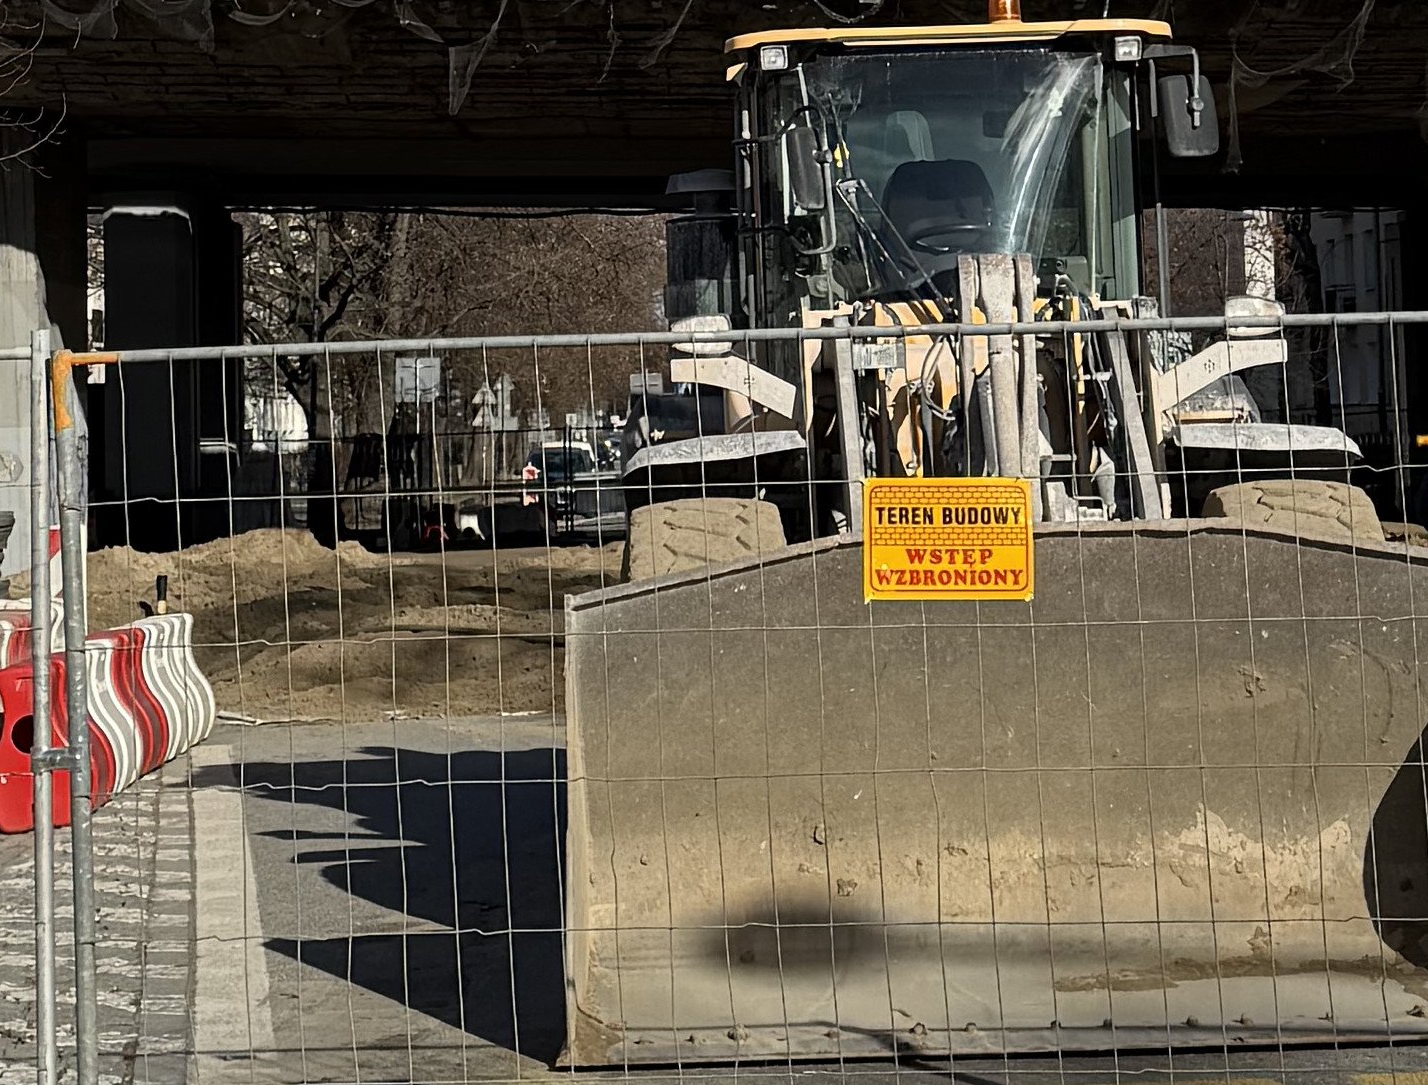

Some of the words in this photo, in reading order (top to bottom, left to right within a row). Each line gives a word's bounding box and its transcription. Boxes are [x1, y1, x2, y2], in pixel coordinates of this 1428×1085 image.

[875, 506, 934, 525] TEREN
[942, 506, 1021, 525] BUDOWY
[905, 548, 994, 568] WSTĘP
[875, 569, 1023, 586] WZBRONIONY
